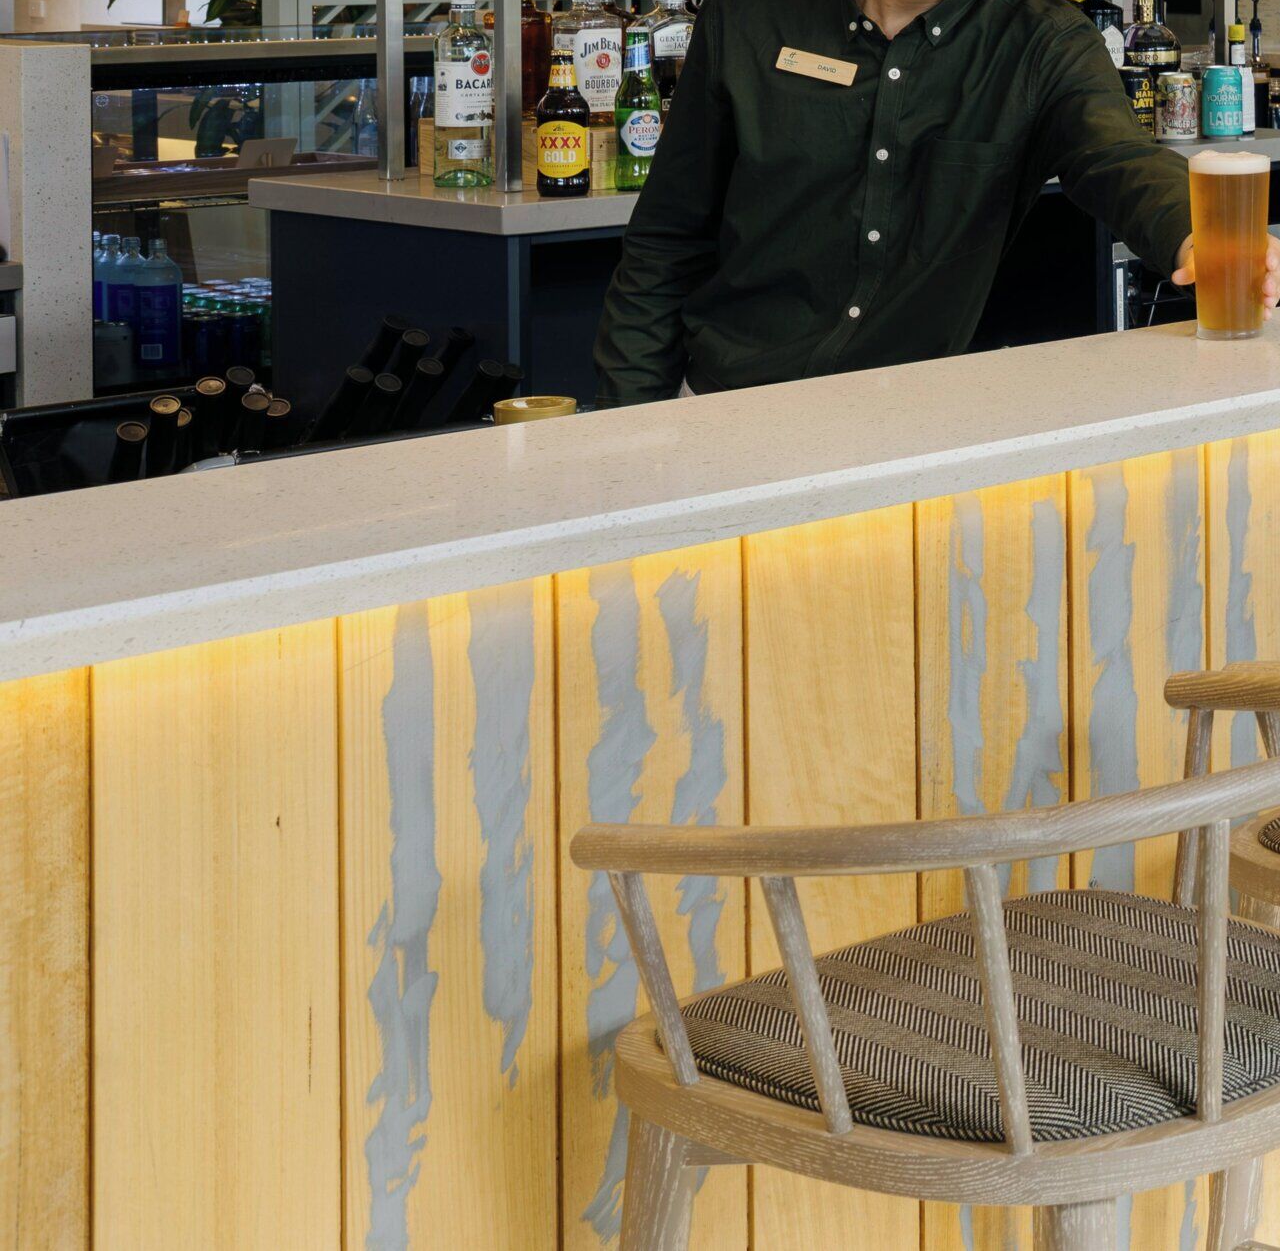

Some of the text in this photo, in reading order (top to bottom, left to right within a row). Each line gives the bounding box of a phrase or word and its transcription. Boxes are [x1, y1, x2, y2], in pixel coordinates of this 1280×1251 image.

[580, 41, 599, 58] JIM
[817, 64, 836, 74] DAVID
[585, 79, 620, 89] BOURBON
[540, 136, 581, 149] XXXX
[544, 150, 576, 163] GOLD
